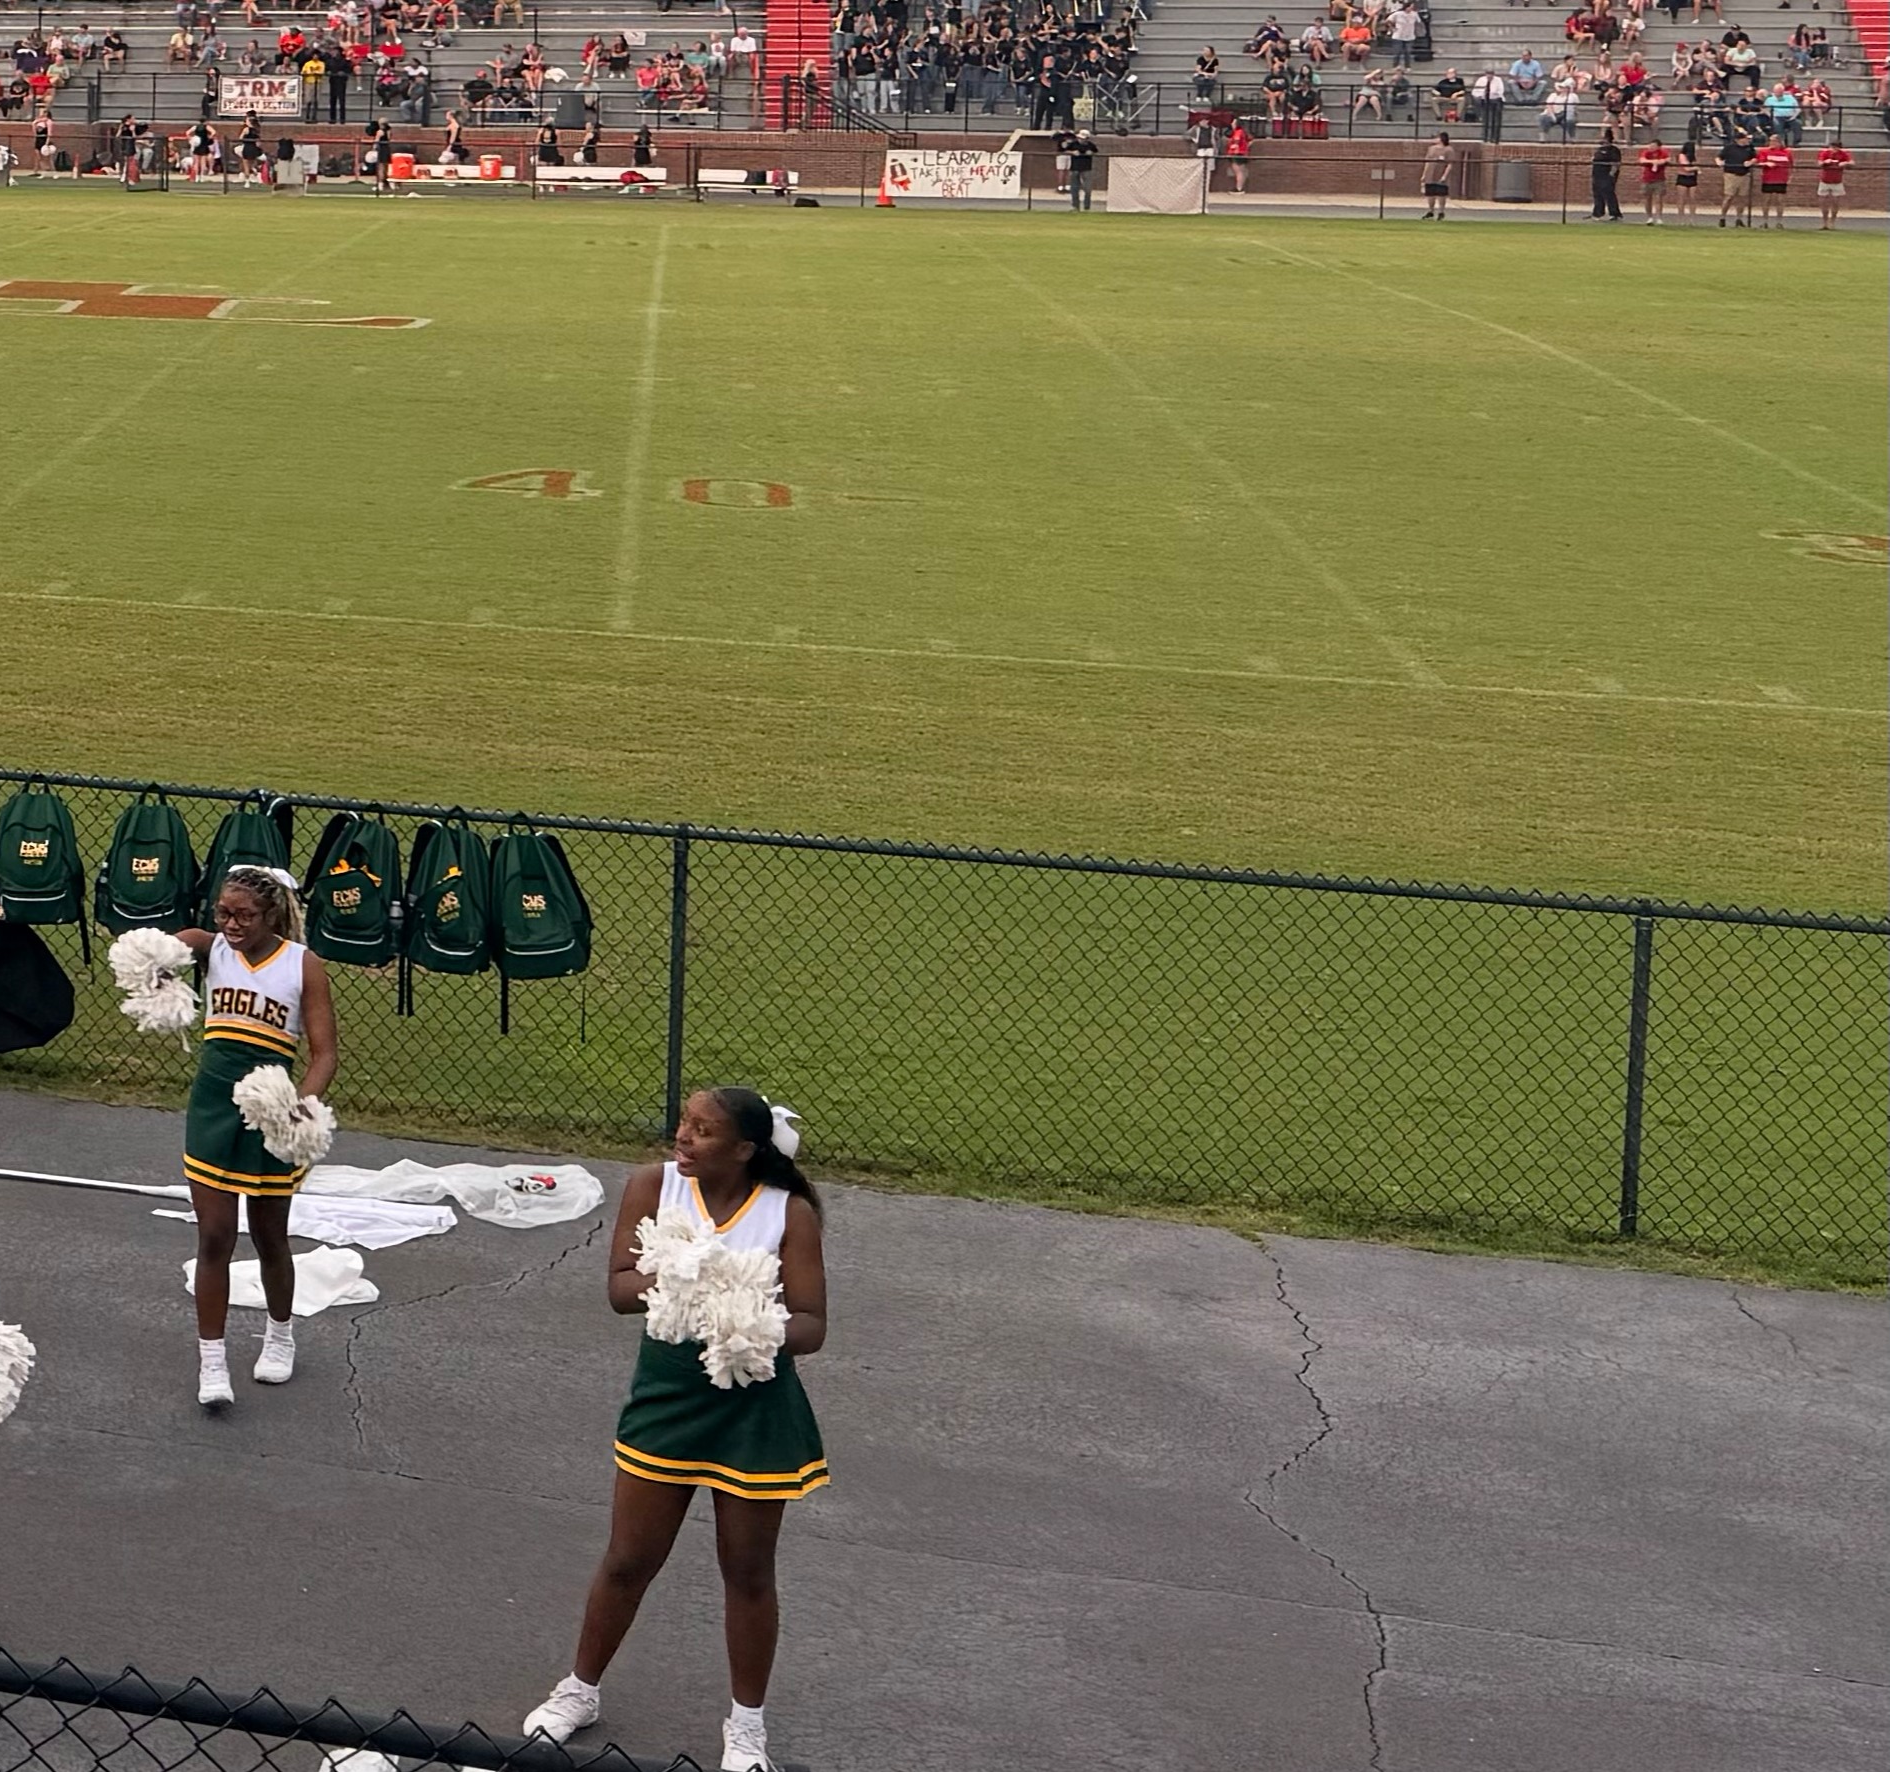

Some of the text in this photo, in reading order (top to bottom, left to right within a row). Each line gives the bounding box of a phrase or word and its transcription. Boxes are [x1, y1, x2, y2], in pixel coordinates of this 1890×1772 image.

[235, 80, 288, 97] TRM
[923, 151, 1009, 166] LEARN TO
[910, 167, 940, 180] TAKE
[970, 164, 1001, 178] HEAT
[452, 467, 799, 511] 40
[211, 987, 290, 1030] EAGLES
